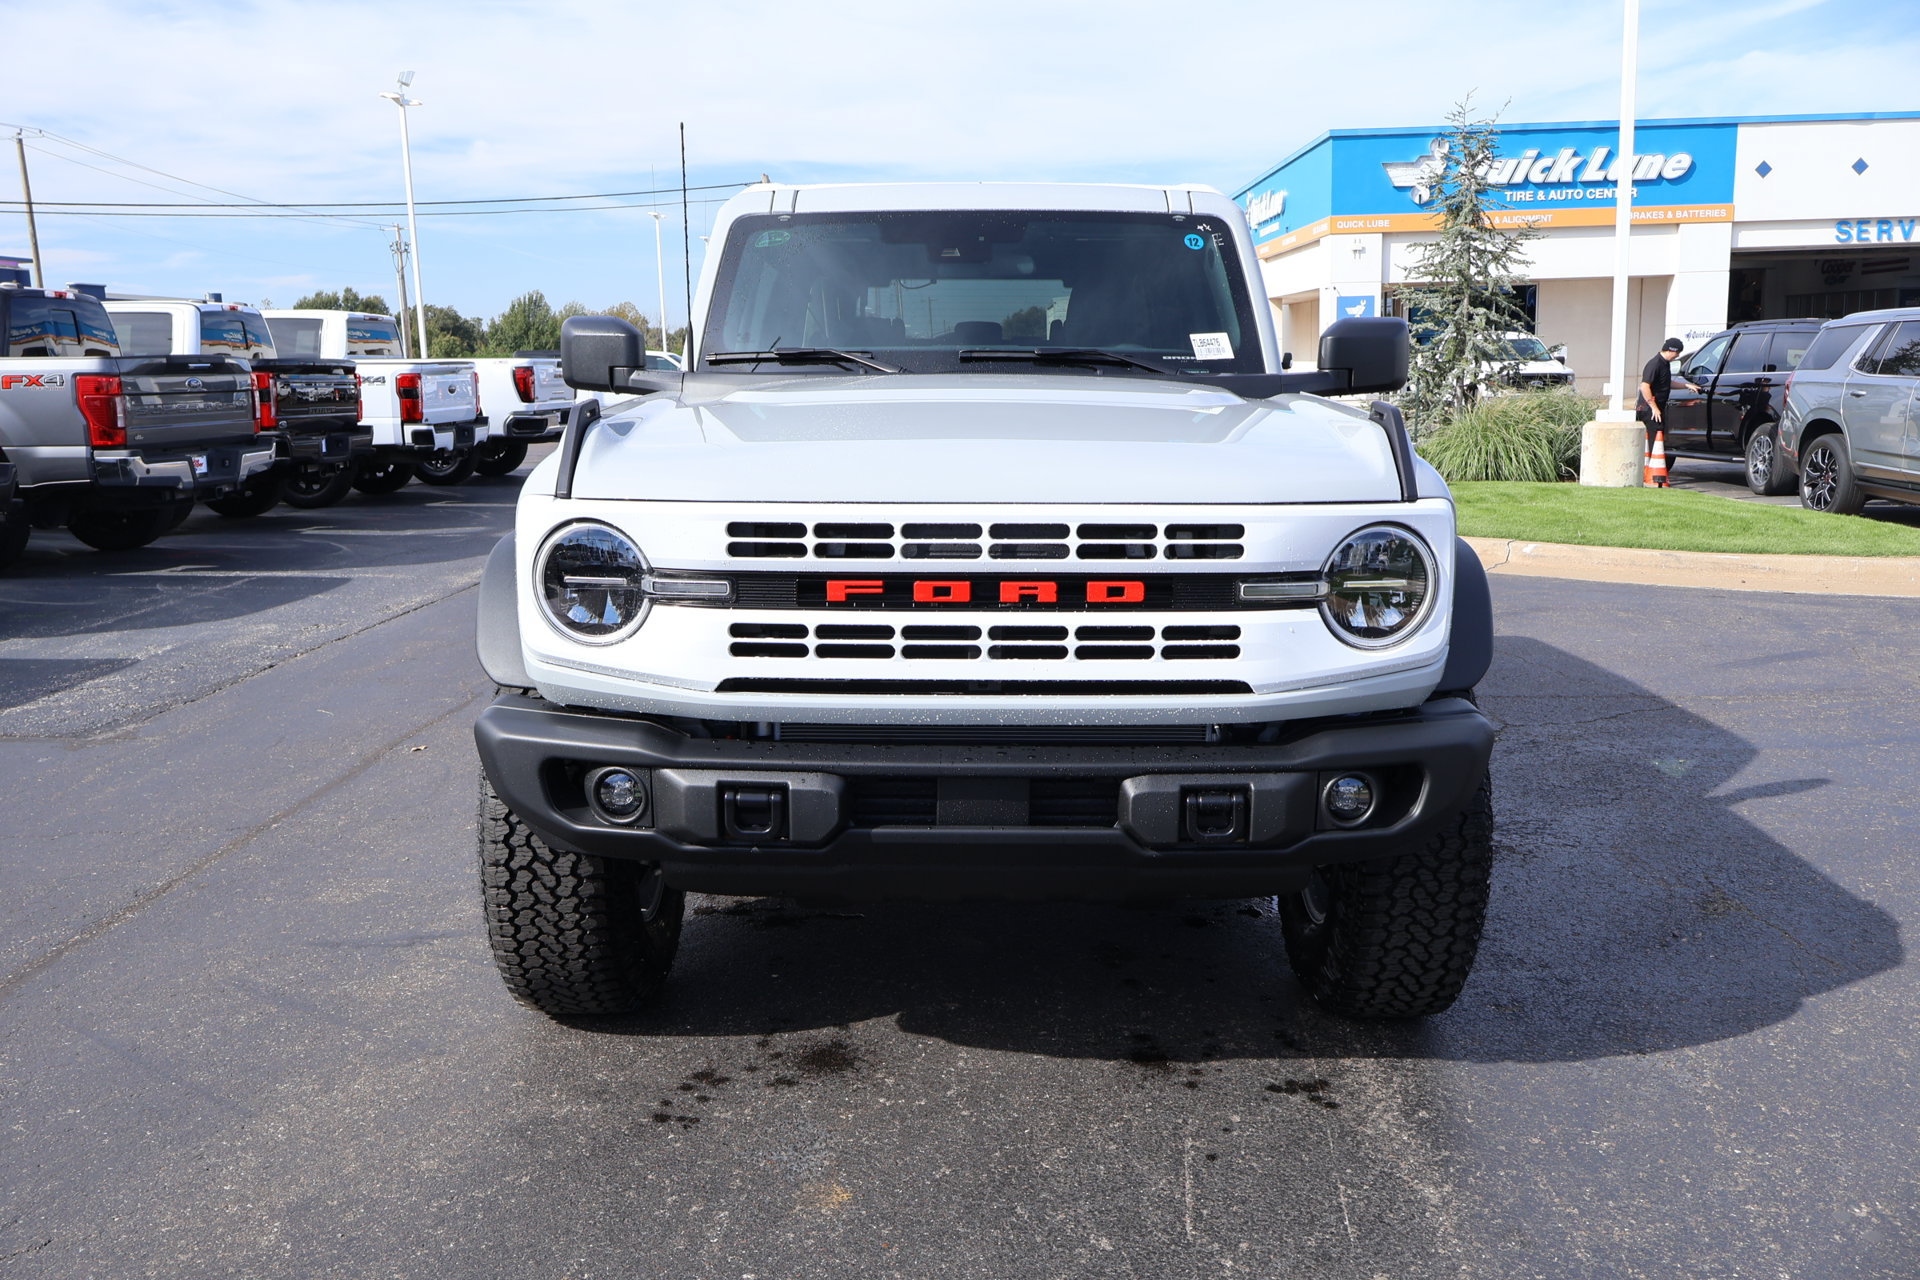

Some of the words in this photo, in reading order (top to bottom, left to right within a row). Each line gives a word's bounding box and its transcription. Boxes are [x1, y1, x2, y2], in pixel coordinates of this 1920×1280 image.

[1505, 191, 1534, 202] TIRE
[1537, 190, 1546, 200] &
[1548, 189, 1584, 200] AUTO
[1586, 187, 1638, 199] CENTR
[1667, 210, 1673, 218] &
[1675, 209, 1727, 218] BATTERIES
[1336, 220, 1364, 229] QUICK
[1366, 219, 1390, 228] LUBE
[1502, 214, 1553, 224] ALIGNMENT
[1835, 219, 1915, 243] SERV
[1187, 238, 1200, 247] 12
[1, 374, 65, 390] FX4
[360, 376, 386, 384] X4
[826, 580, 1145, 602] FORD
